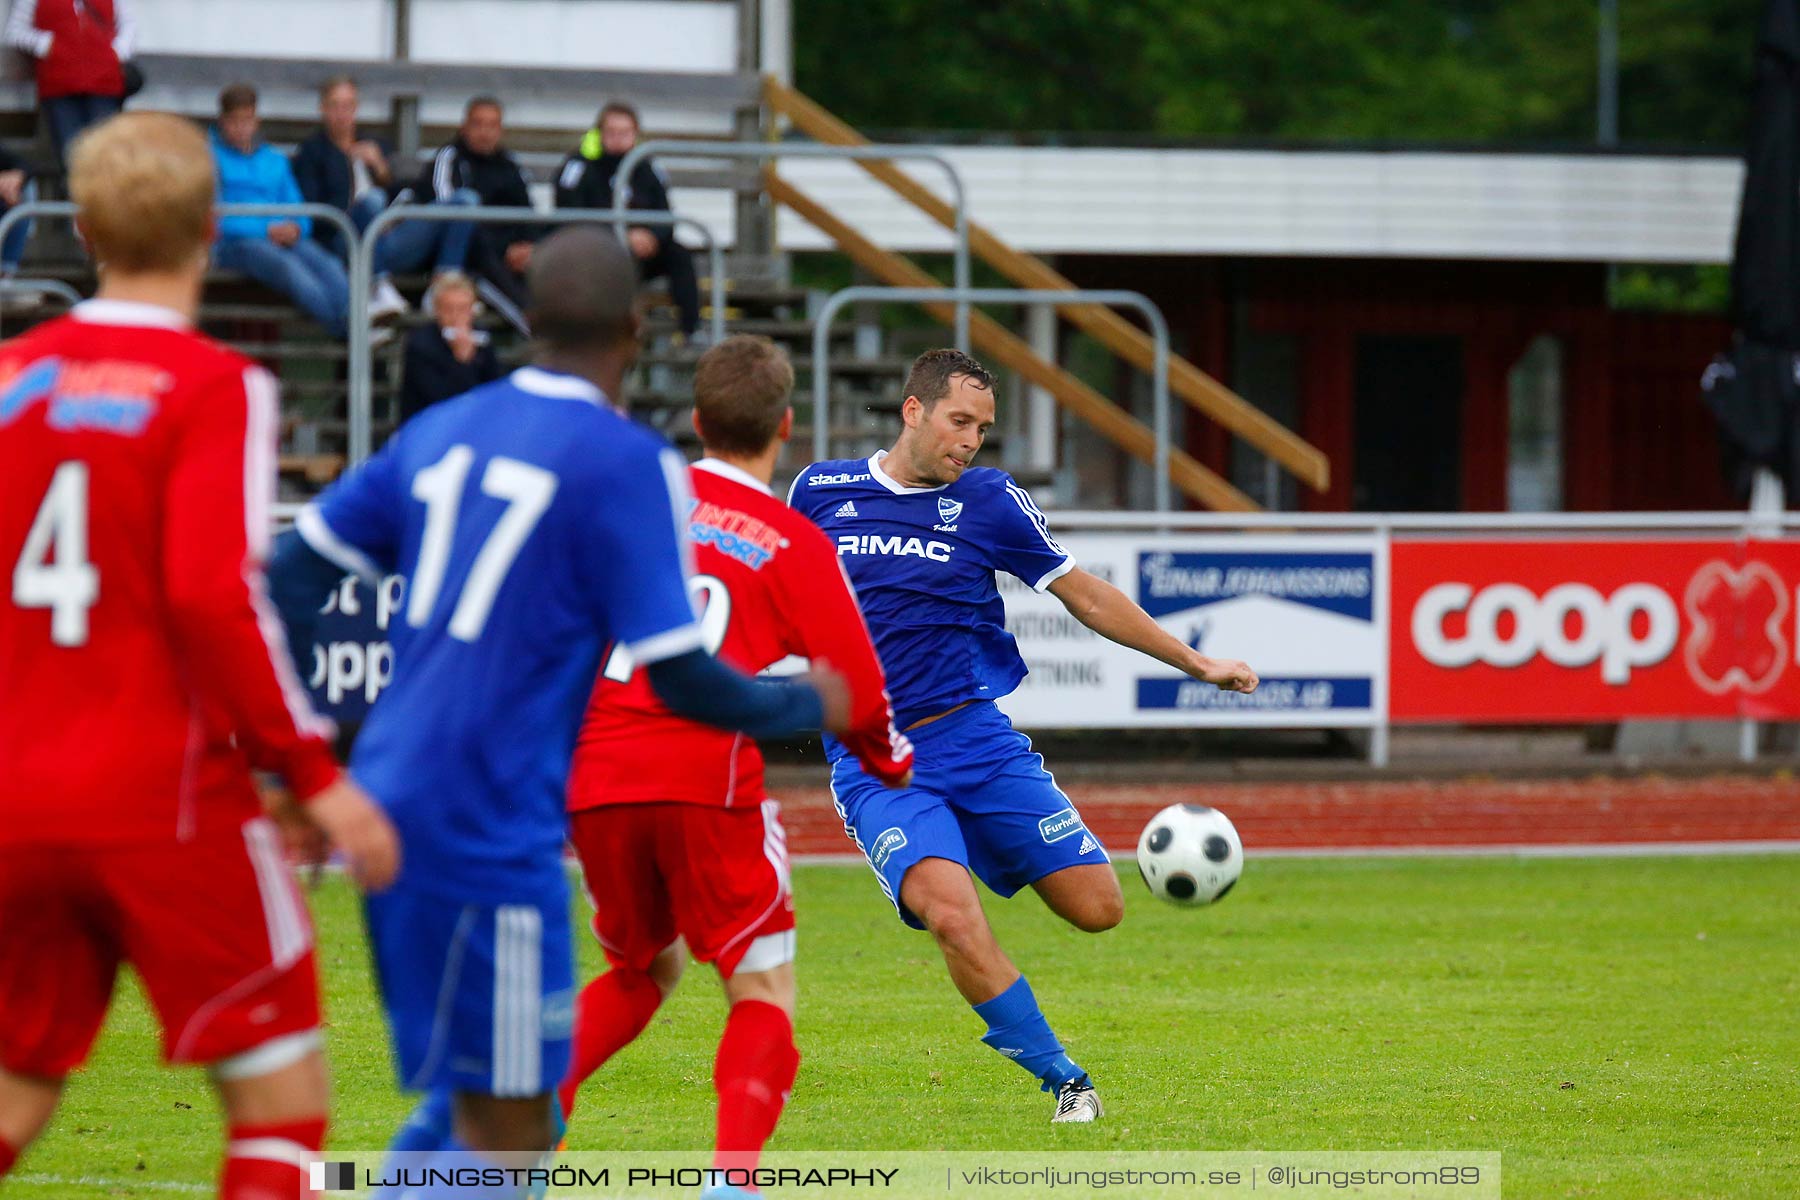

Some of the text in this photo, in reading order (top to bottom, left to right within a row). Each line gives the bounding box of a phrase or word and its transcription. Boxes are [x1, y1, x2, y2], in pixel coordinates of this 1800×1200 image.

[808, 473, 870, 486] stadium
[11, 459, 100, 647] 4
[406, 444, 559, 643] 17
[687, 524, 772, 571] SPORT
[693, 502, 783, 552] INTER
[1411, 581, 1680, 685] coop
